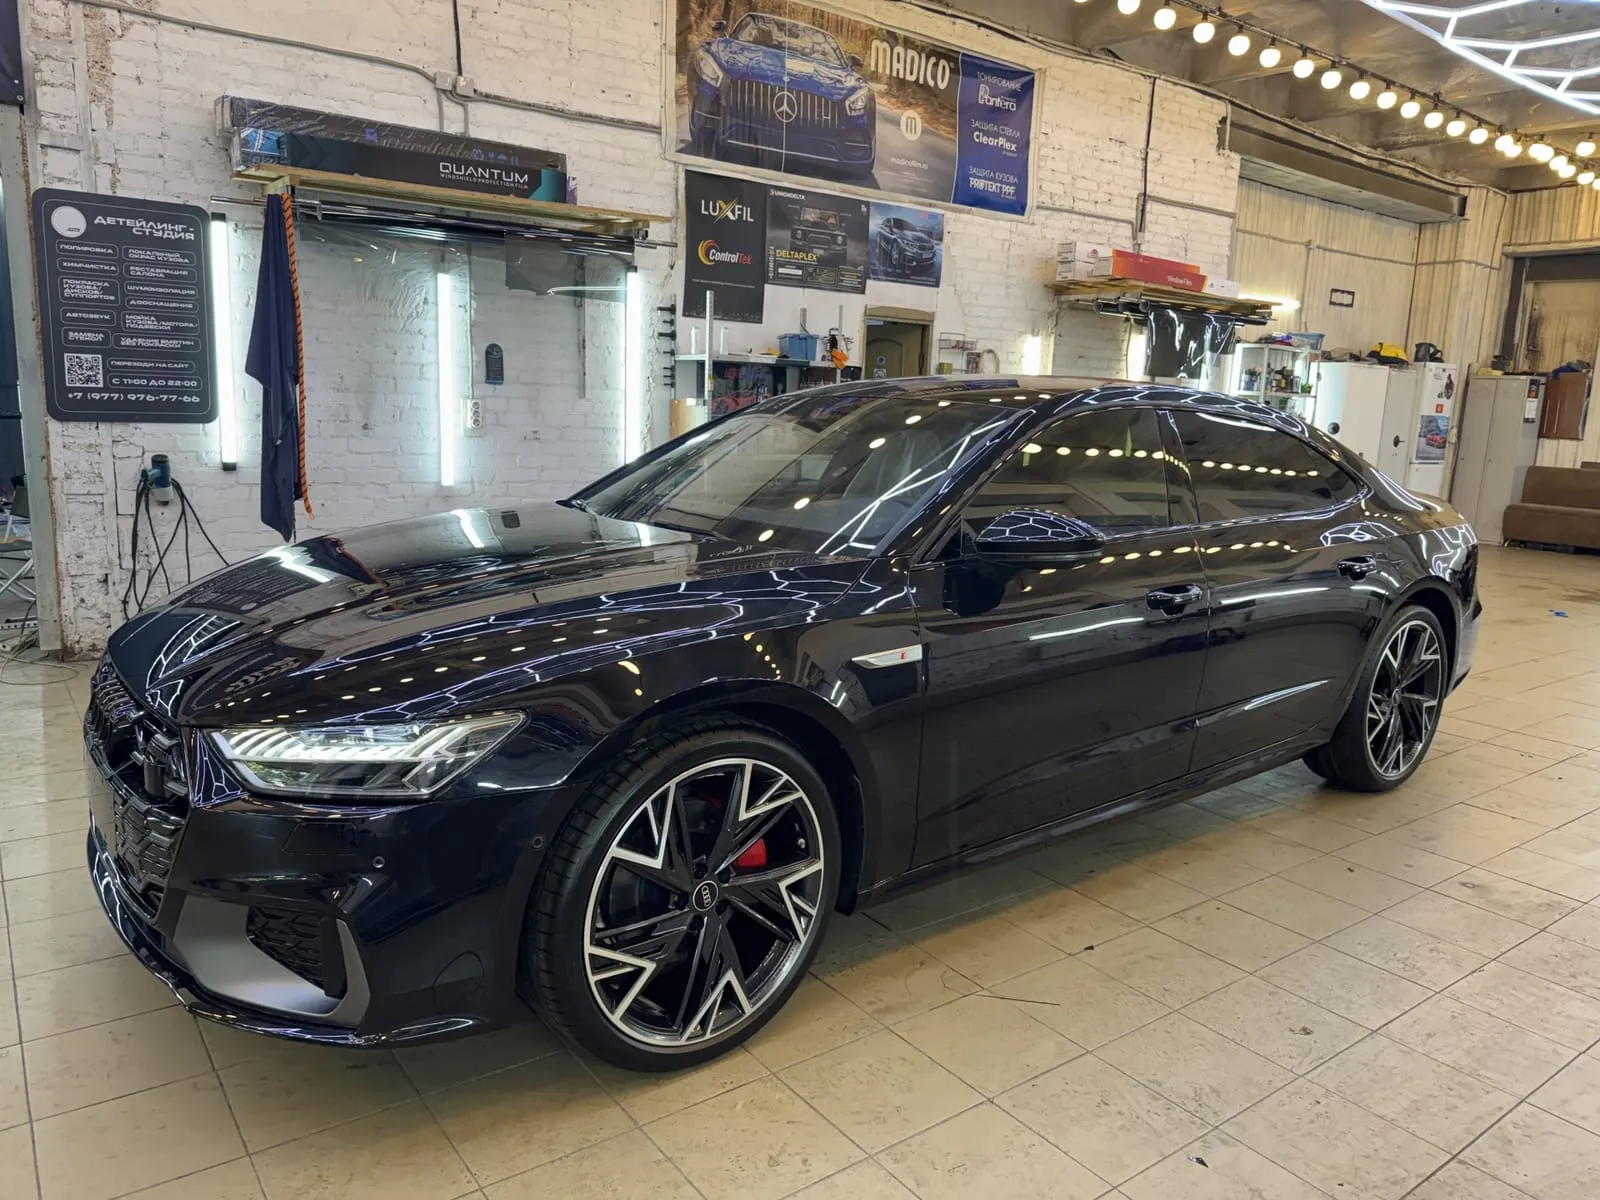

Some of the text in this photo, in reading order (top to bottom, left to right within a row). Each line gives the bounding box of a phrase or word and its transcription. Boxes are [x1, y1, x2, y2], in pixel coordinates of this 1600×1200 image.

[870, 39, 950, 90] MADICO
[977, 72, 1022, 91] ТОНИРОВАНИЕ
[978, 83, 1017, 111] Pantera
[971, 119, 1021, 138] ЗАЩИТА СТЕКЛА
[973, 131, 1017, 152] ClearPlex
[440, 162, 528, 183] QUANTUM
[968, 165, 1019, 184] ЗАЩИТА КУЗОВА
[440, 173, 477, 182] WINDSHIELD
[477, 178, 515, 187] PROTECTION
[1001, 185, 1016, 196] PPF
[701, 198, 754, 223] LUXFIL
[133, 227, 195, 240] СТУДИЯ
[60, 244, 114, 253] ПОЛИРОВКА
[776, 249, 818, 261] DELTAPLEX
[709, 249, 753, 265] ControlTek
[62, 261, 117, 271] ХИМЧИСТКА
[130, 266, 189, 275] РЕСТАВРАЦИЯ
[63, 279, 110, 287] ПОКРАСКА
[127, 285, 195, 294] ШУМОИЗОЛЯЦИЯ
[129, 300, 193, 308] ДООСНАЩЕНИЕ
[65, 312, 111, 320] АВТОЗВУК
[87, 392, 124, 400] (977)
